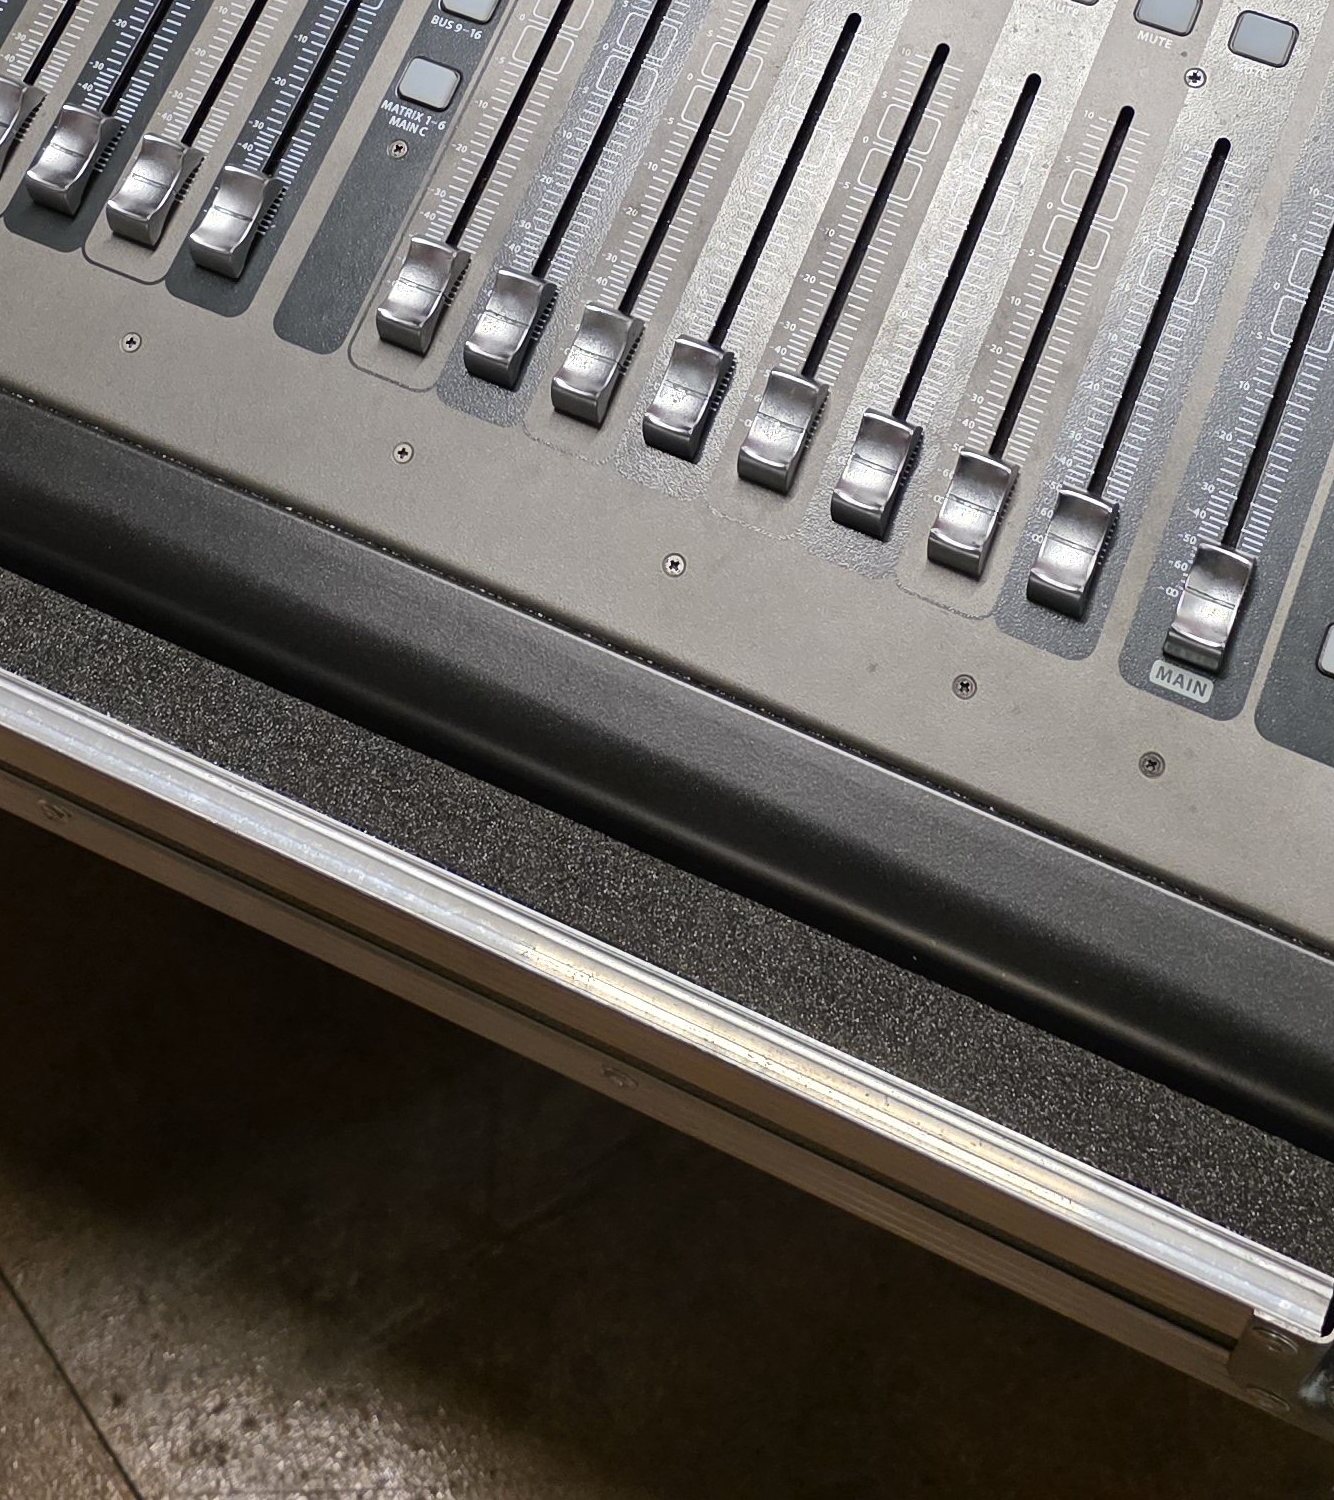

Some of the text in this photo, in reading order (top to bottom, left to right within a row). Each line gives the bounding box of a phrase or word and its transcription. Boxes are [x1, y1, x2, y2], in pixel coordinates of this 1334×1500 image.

[430, 15, 483, 40] BUS 9-16
[380, 100, 447, 131] MATRIX 1-6
[388, 115, 429, 137] MAIN C
[1154, 665, 1208, 698] MAIN
